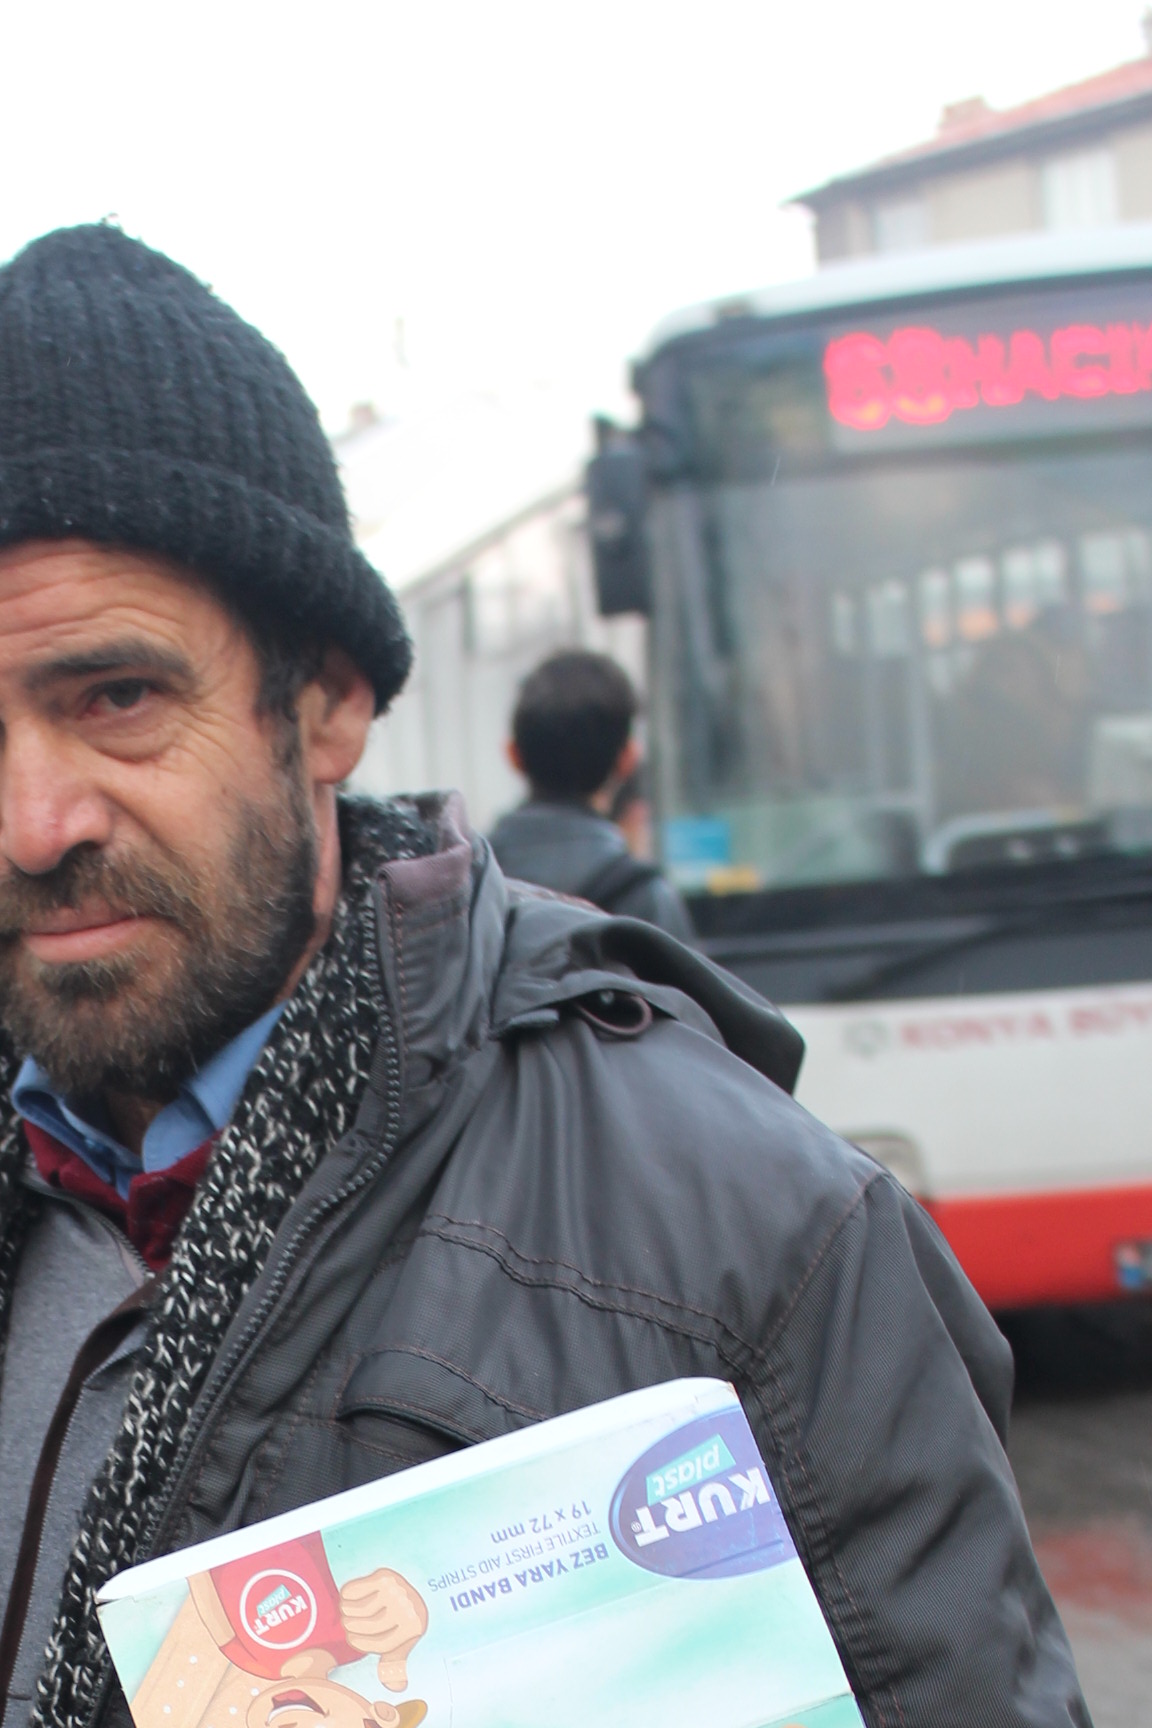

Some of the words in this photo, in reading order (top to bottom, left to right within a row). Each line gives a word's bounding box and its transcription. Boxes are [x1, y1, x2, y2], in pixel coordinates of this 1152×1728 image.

[652, 1442, 721, 1497] plast
[554, 1508, 567, 1522] x
[571, 1500, 592, 1520] 19
[632, 1466, 771, 1548] KURT
[490, 1522, 526, 1544] mm
[529, 1514, 553, 1534] 72
[544, 1521, 601, 1551] TEXTILE
[478, 1556, 502, 1574] AID
[505, 1541, 544, 1567] FIRST
[569, 1542, 610, 1570] BEZ
[427, 1564, 478, 1593] STRIPS
[514, 1558, 569, 1588] YARA
[449, 1577, 513, 1612] BANDI
[254, 1595, 308, 1636] KURT
